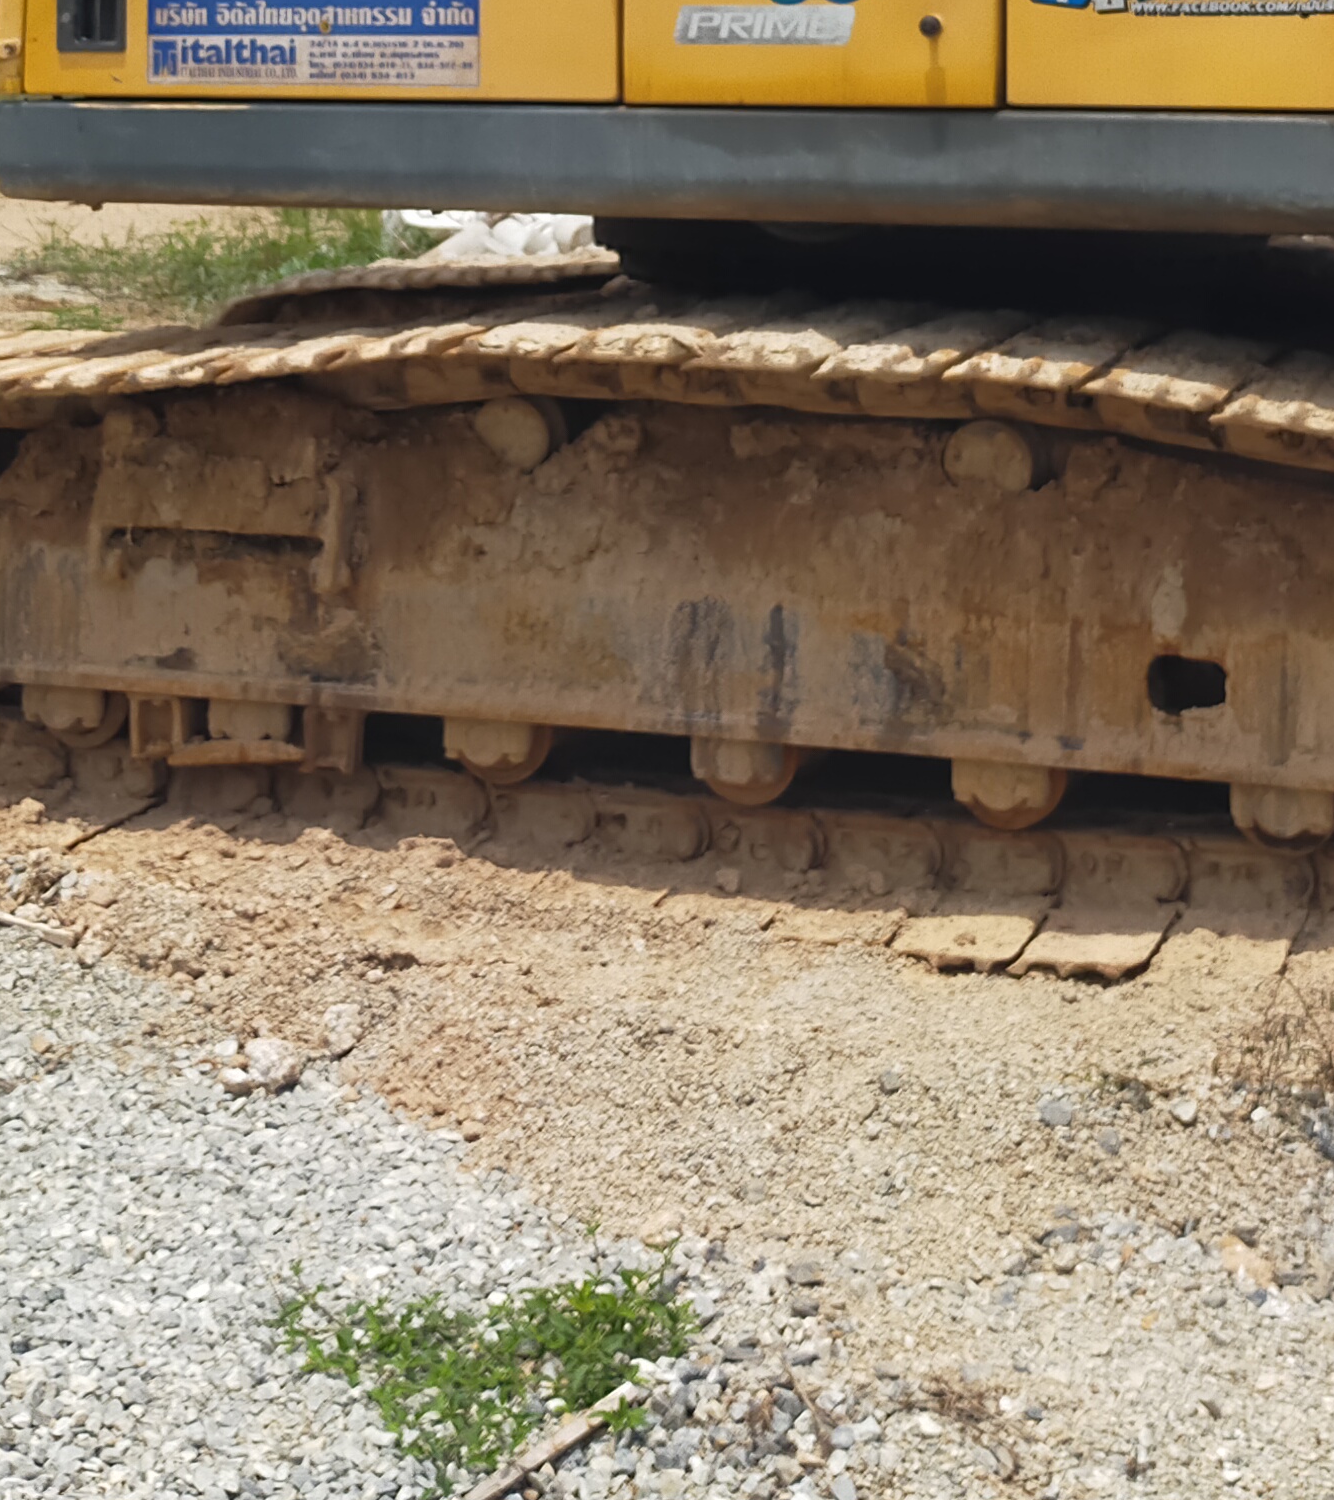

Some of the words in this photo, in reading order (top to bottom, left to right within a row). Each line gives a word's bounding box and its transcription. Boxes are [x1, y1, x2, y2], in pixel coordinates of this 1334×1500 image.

[155, 1, 208, 27] บริษัท
[421, 0, 475, 27] จำกัด
[180, 38, 297, 65] italthai
